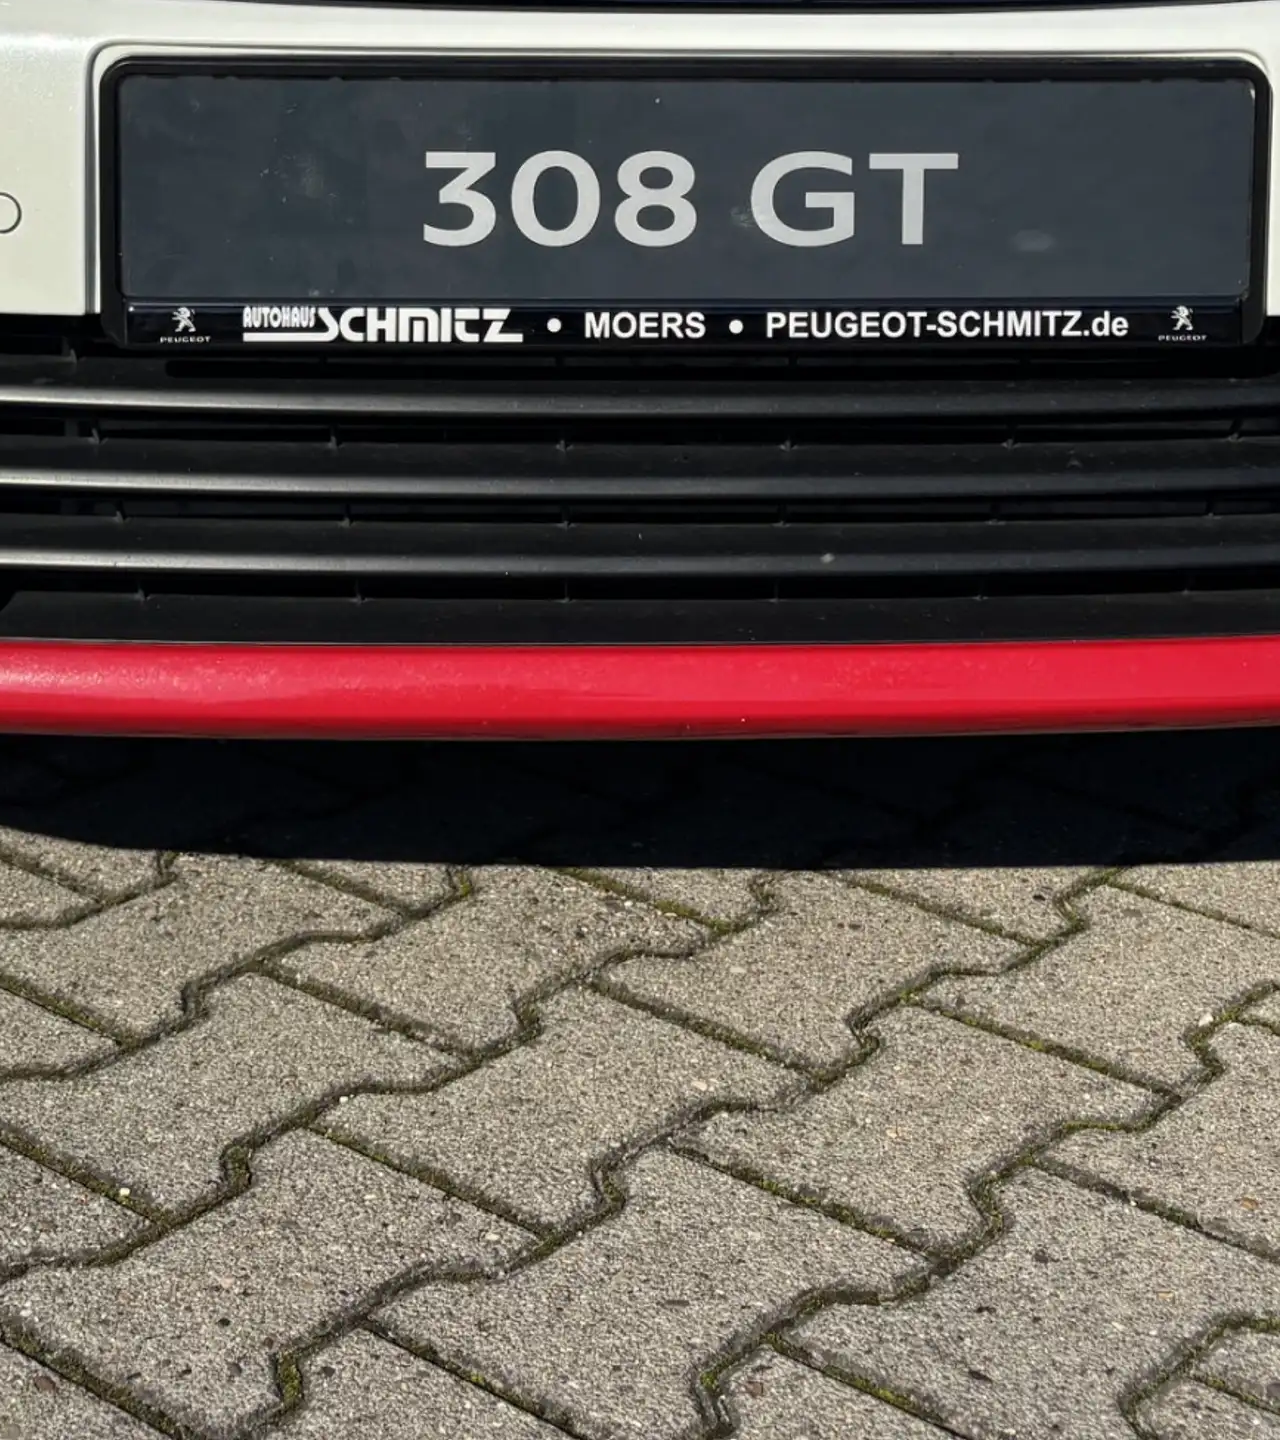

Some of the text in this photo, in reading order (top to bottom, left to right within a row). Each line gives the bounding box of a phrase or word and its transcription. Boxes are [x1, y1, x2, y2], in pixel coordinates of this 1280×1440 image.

[423, 150, 959, 247] 308 GT
[160, 335, 211, 343] PEUGEOT
[243, 305, 1129, 342] AUTOHAUS SCHMITZ MOERS PEUGEOT-SCHMITZ.de
